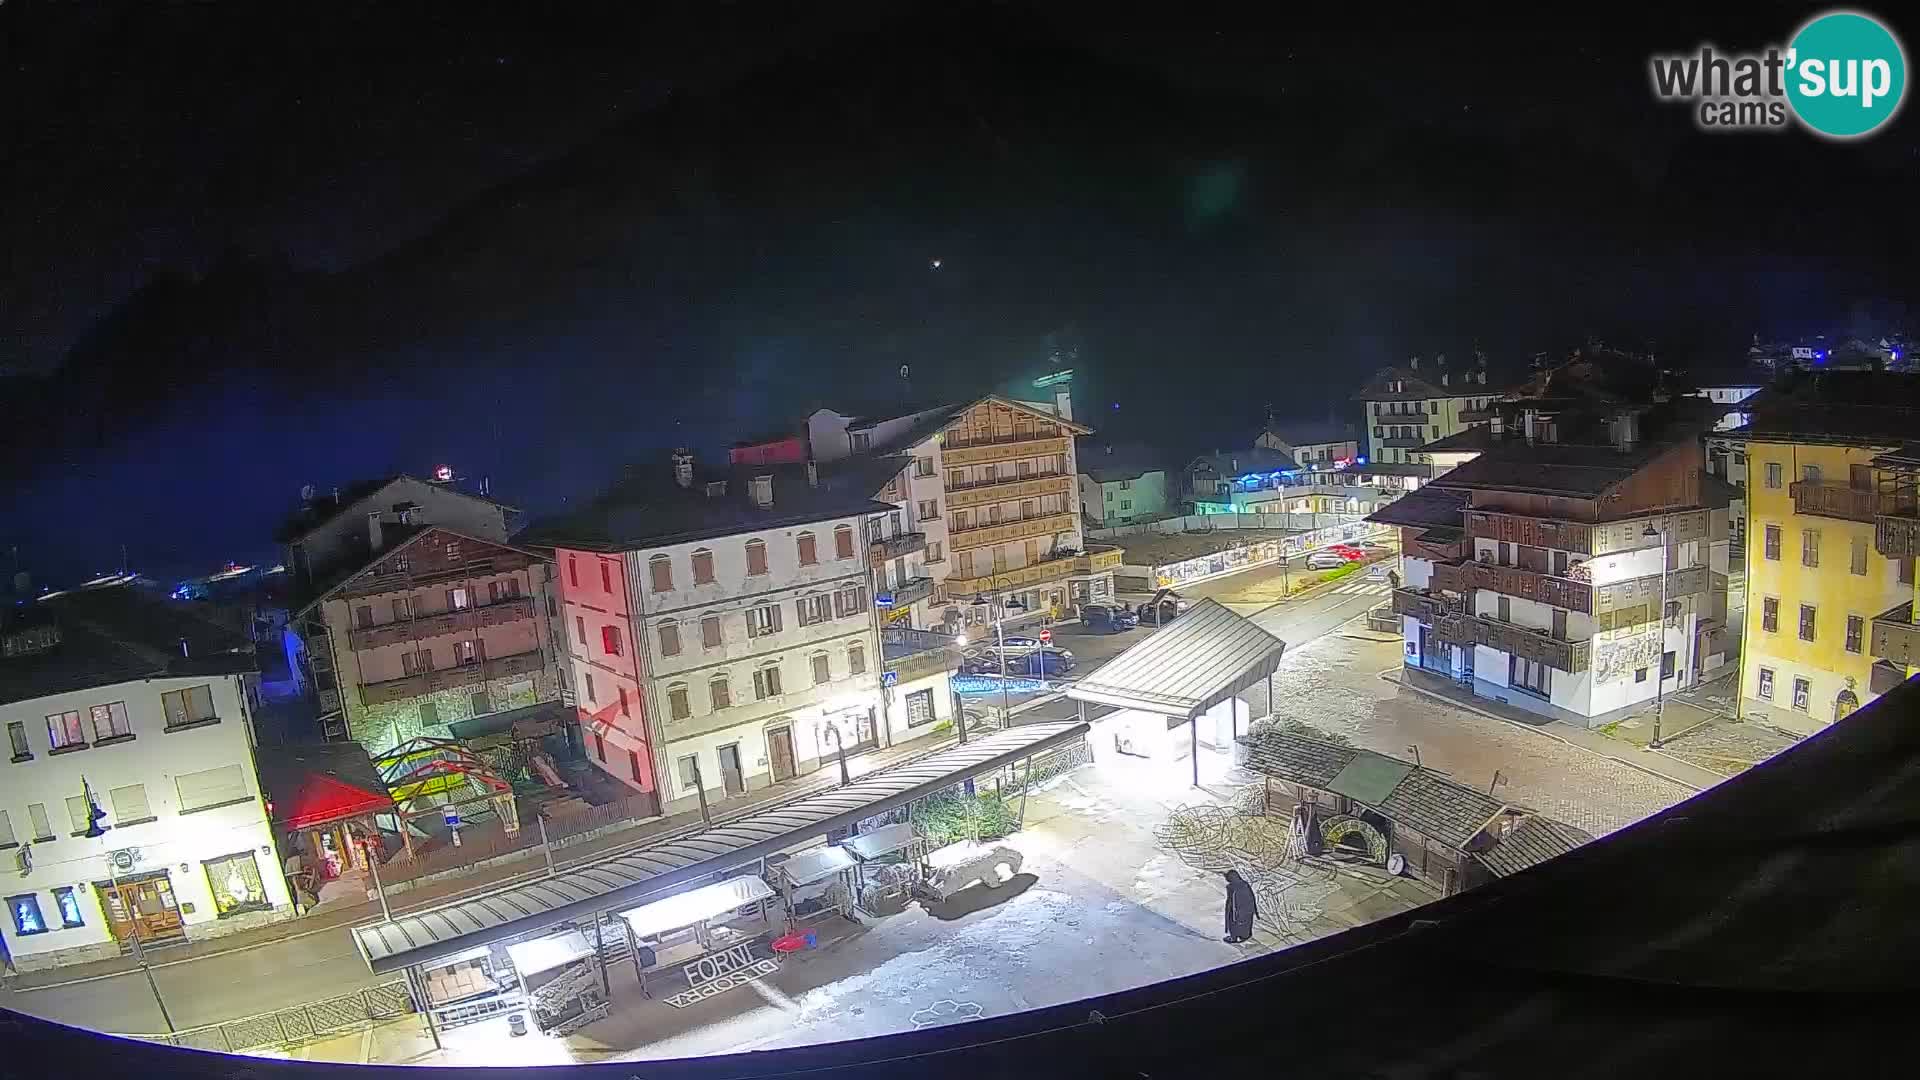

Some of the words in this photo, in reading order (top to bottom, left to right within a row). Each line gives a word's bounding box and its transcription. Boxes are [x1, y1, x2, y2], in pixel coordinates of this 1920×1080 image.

[683, 942, 754, 987] FORNI
[753, 959, 779, 977] DI
[663, 971, 751, 1008] SOPRA
